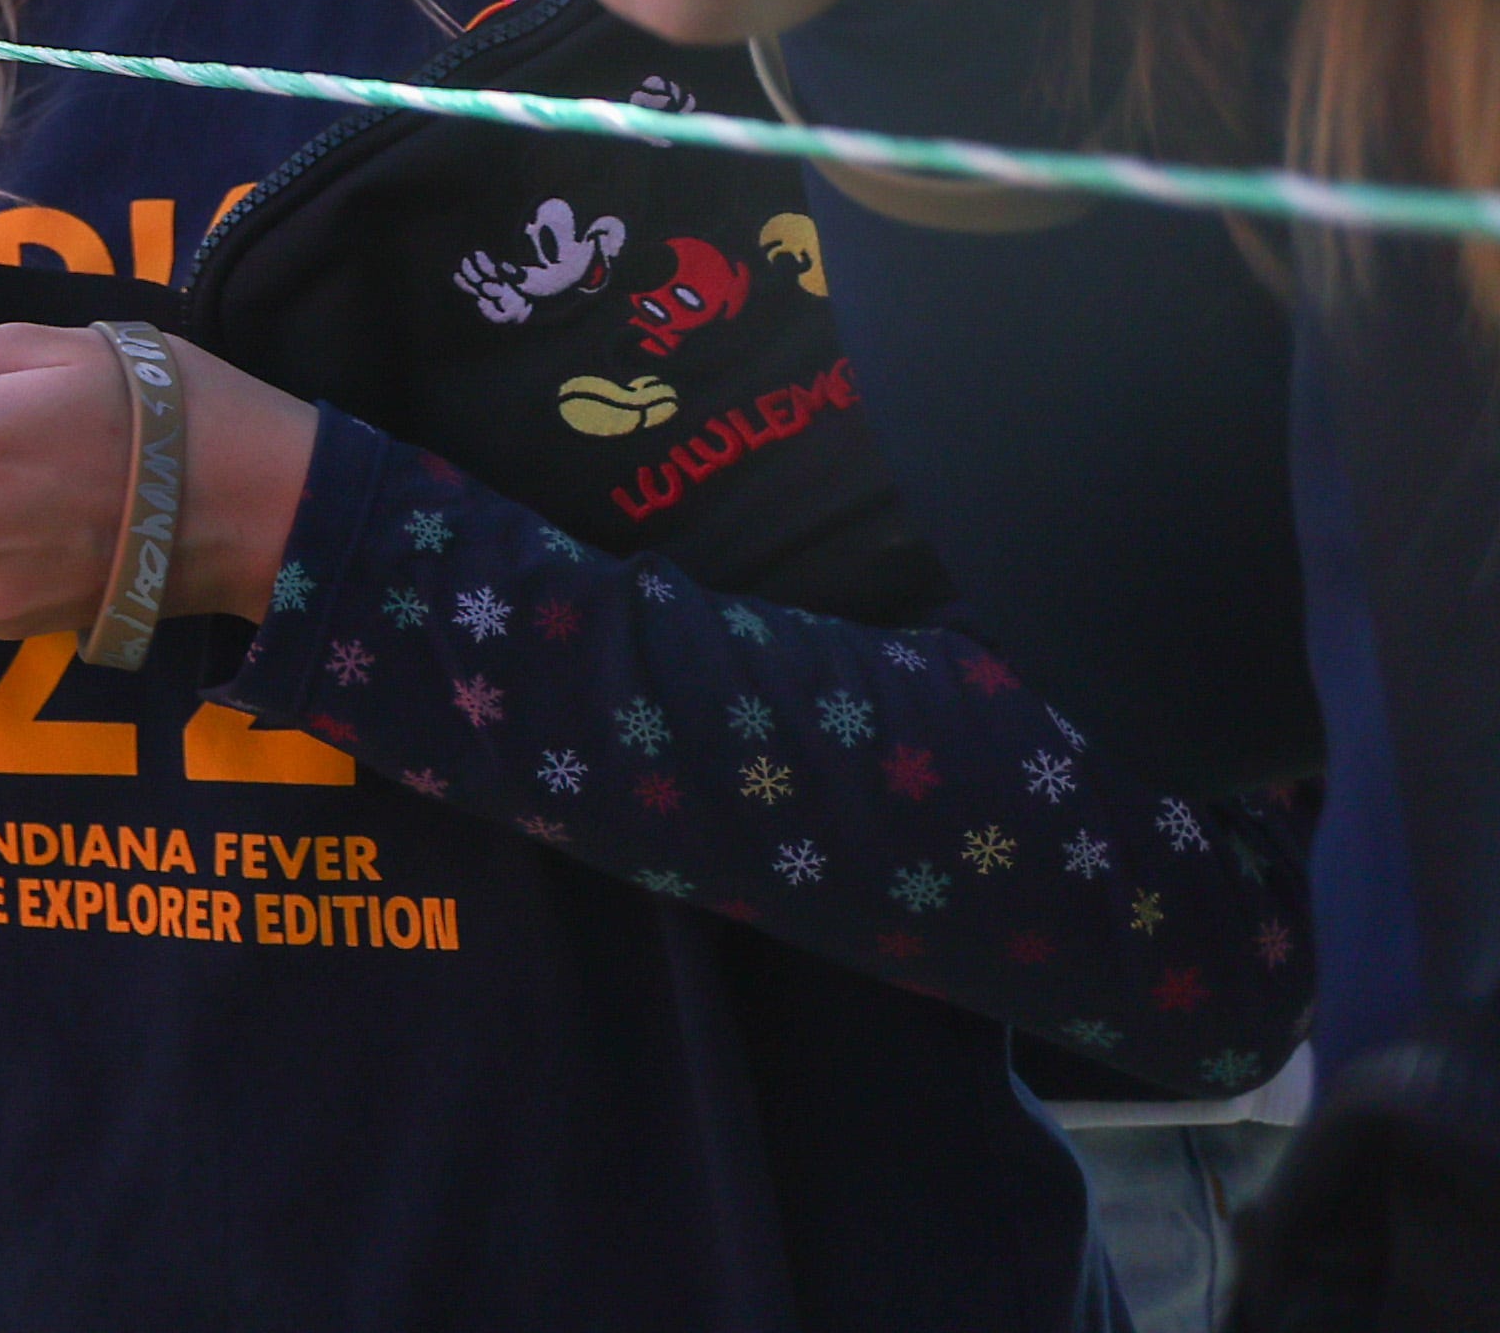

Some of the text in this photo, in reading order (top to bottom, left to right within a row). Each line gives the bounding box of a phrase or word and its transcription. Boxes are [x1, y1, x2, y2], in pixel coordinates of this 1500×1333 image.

[213, 832, 383, 882] FEVER
[17, 877, 242, 943] EXPLORER
[254, 893, 460, 951] EDITION
